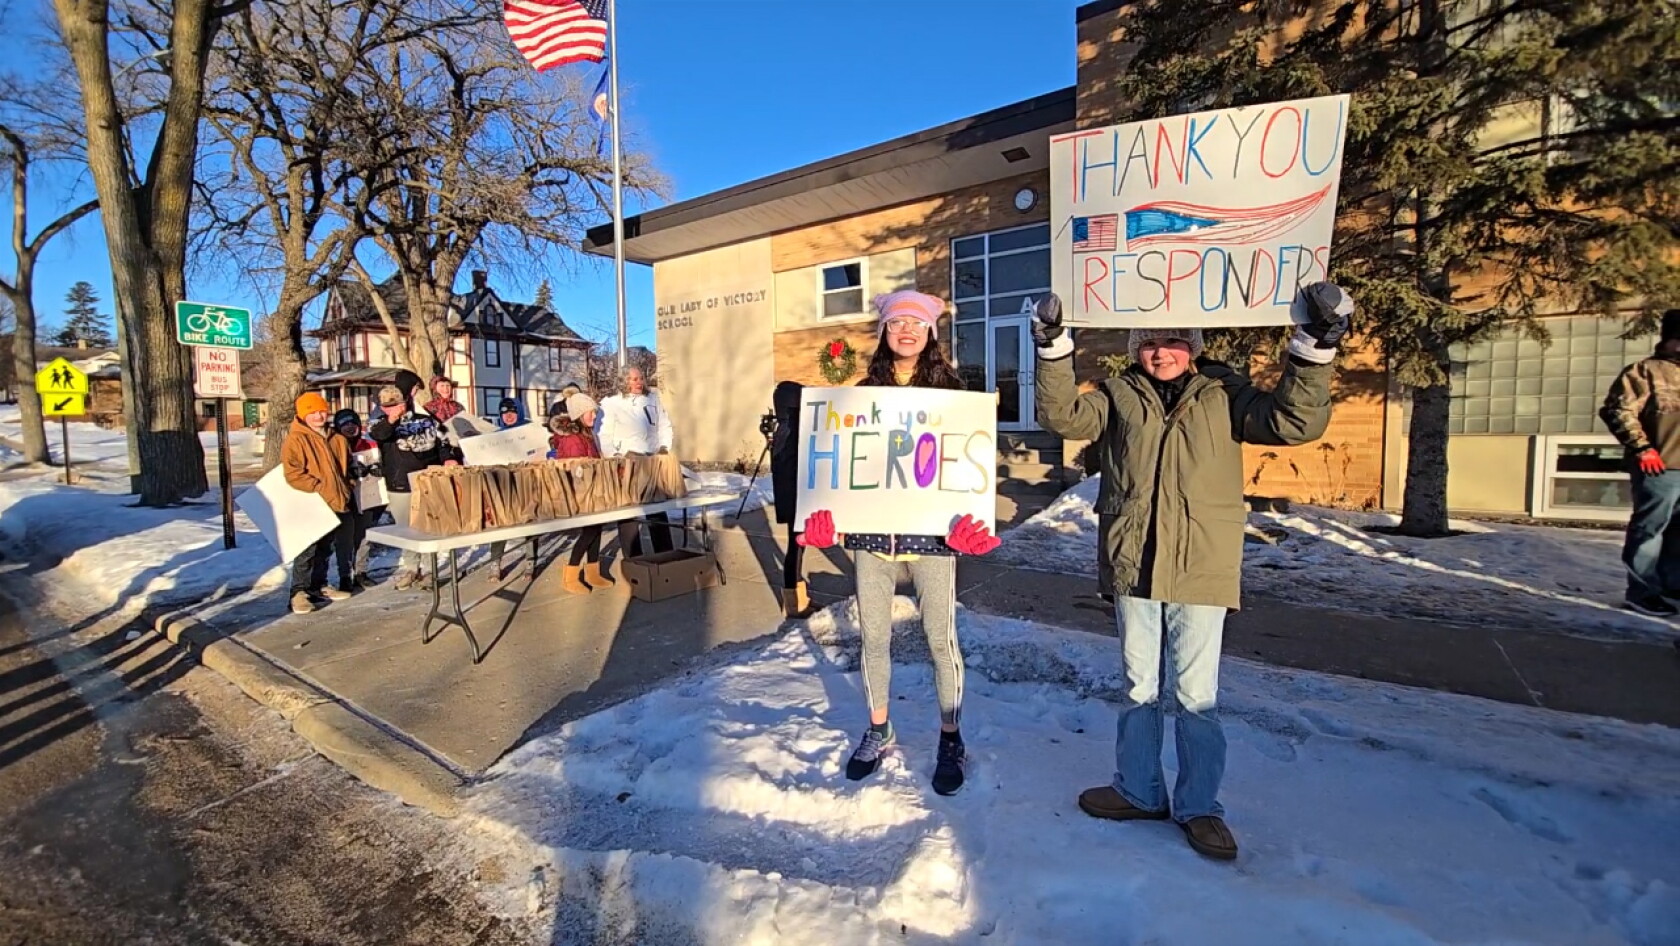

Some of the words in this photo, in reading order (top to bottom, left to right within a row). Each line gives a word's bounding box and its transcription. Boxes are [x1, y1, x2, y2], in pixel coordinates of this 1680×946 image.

[1052, 114, 1219, 204] THANK
[1227, 101, 1342, 179] YOU
[706, 297, 719, 309] OF
[723, 289, 766, 306] VICTORY
[657, 316, 693, 330] SCHOOL
[184, 332, 209, 343] BIKE
[214, 335, 247, 346] ROUTE
[209, 351, 226, 361] NO
[201, 362, 236, 373] PARKING
[806, 401, 882, 431] Thank
[899, 410, 942, 440] you
[807, 430, 993, 494] HEROES
